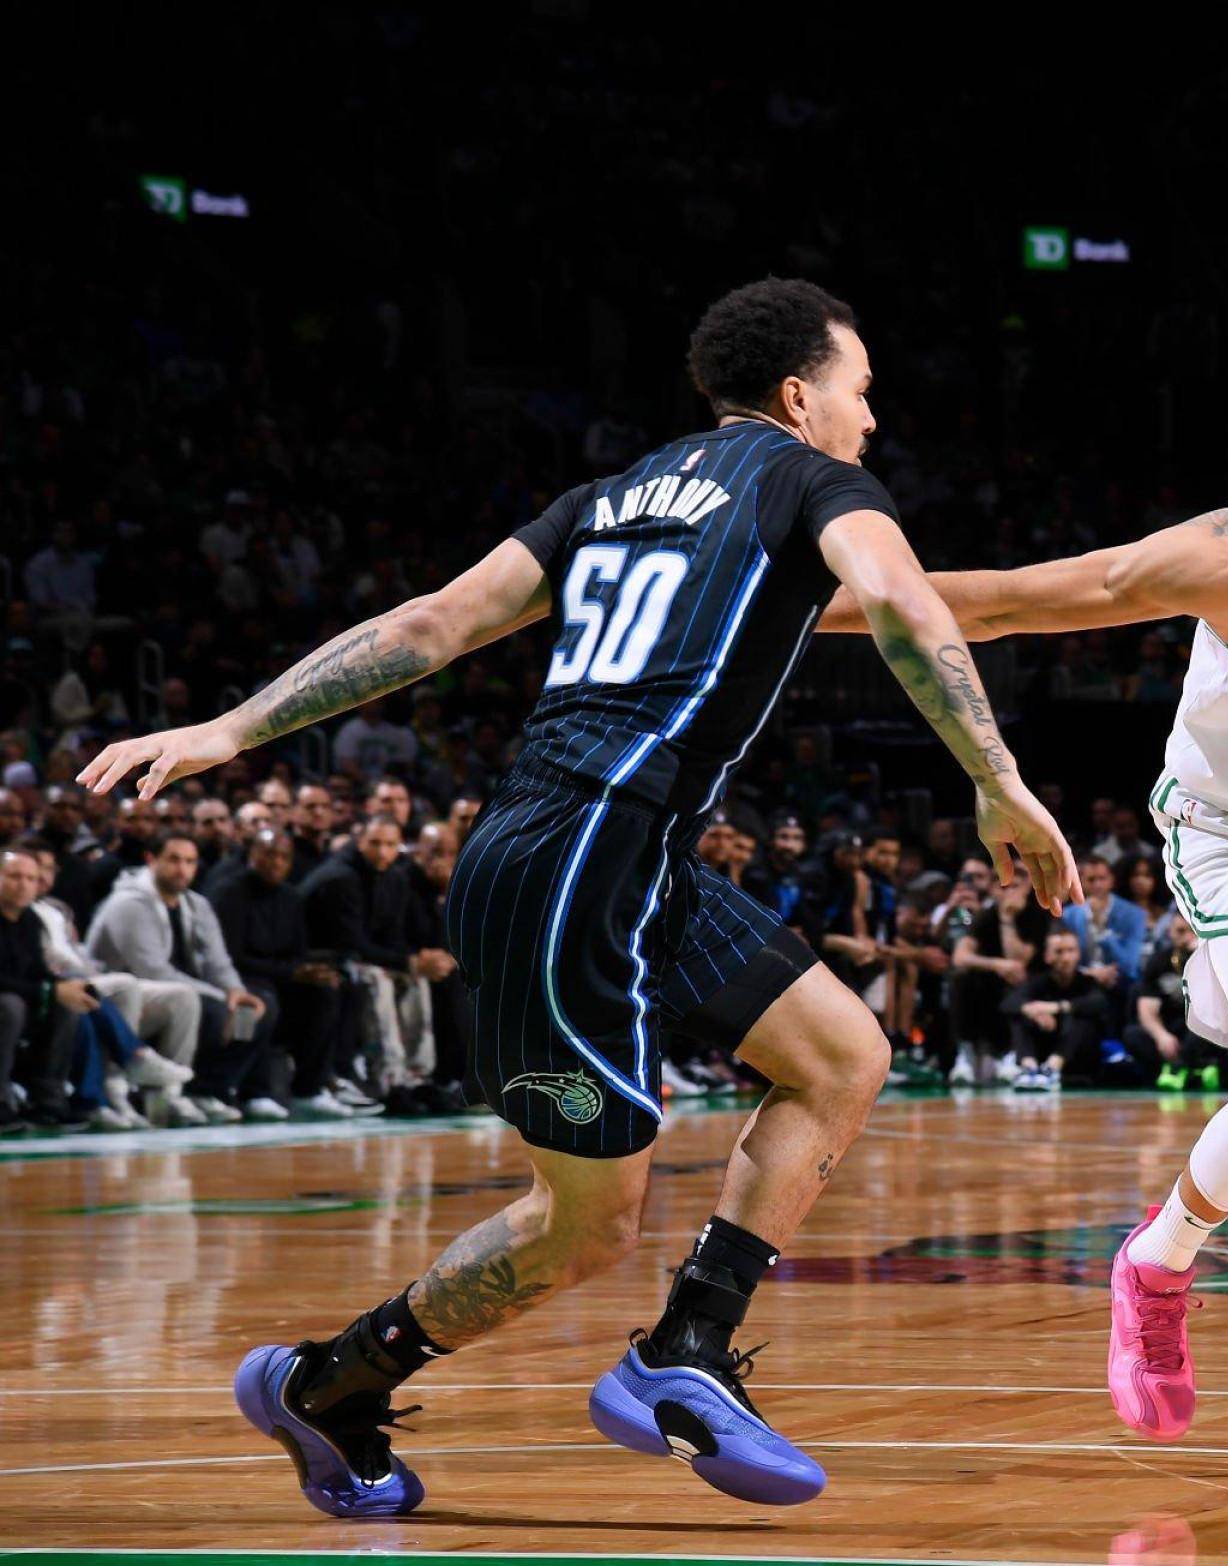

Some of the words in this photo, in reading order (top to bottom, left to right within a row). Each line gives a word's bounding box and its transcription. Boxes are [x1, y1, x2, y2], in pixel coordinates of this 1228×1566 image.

[594, 474, 731, 531] ANTHONY
[544, 544, 690, 692] 50
[937, 644, 991, 726] Crystal
